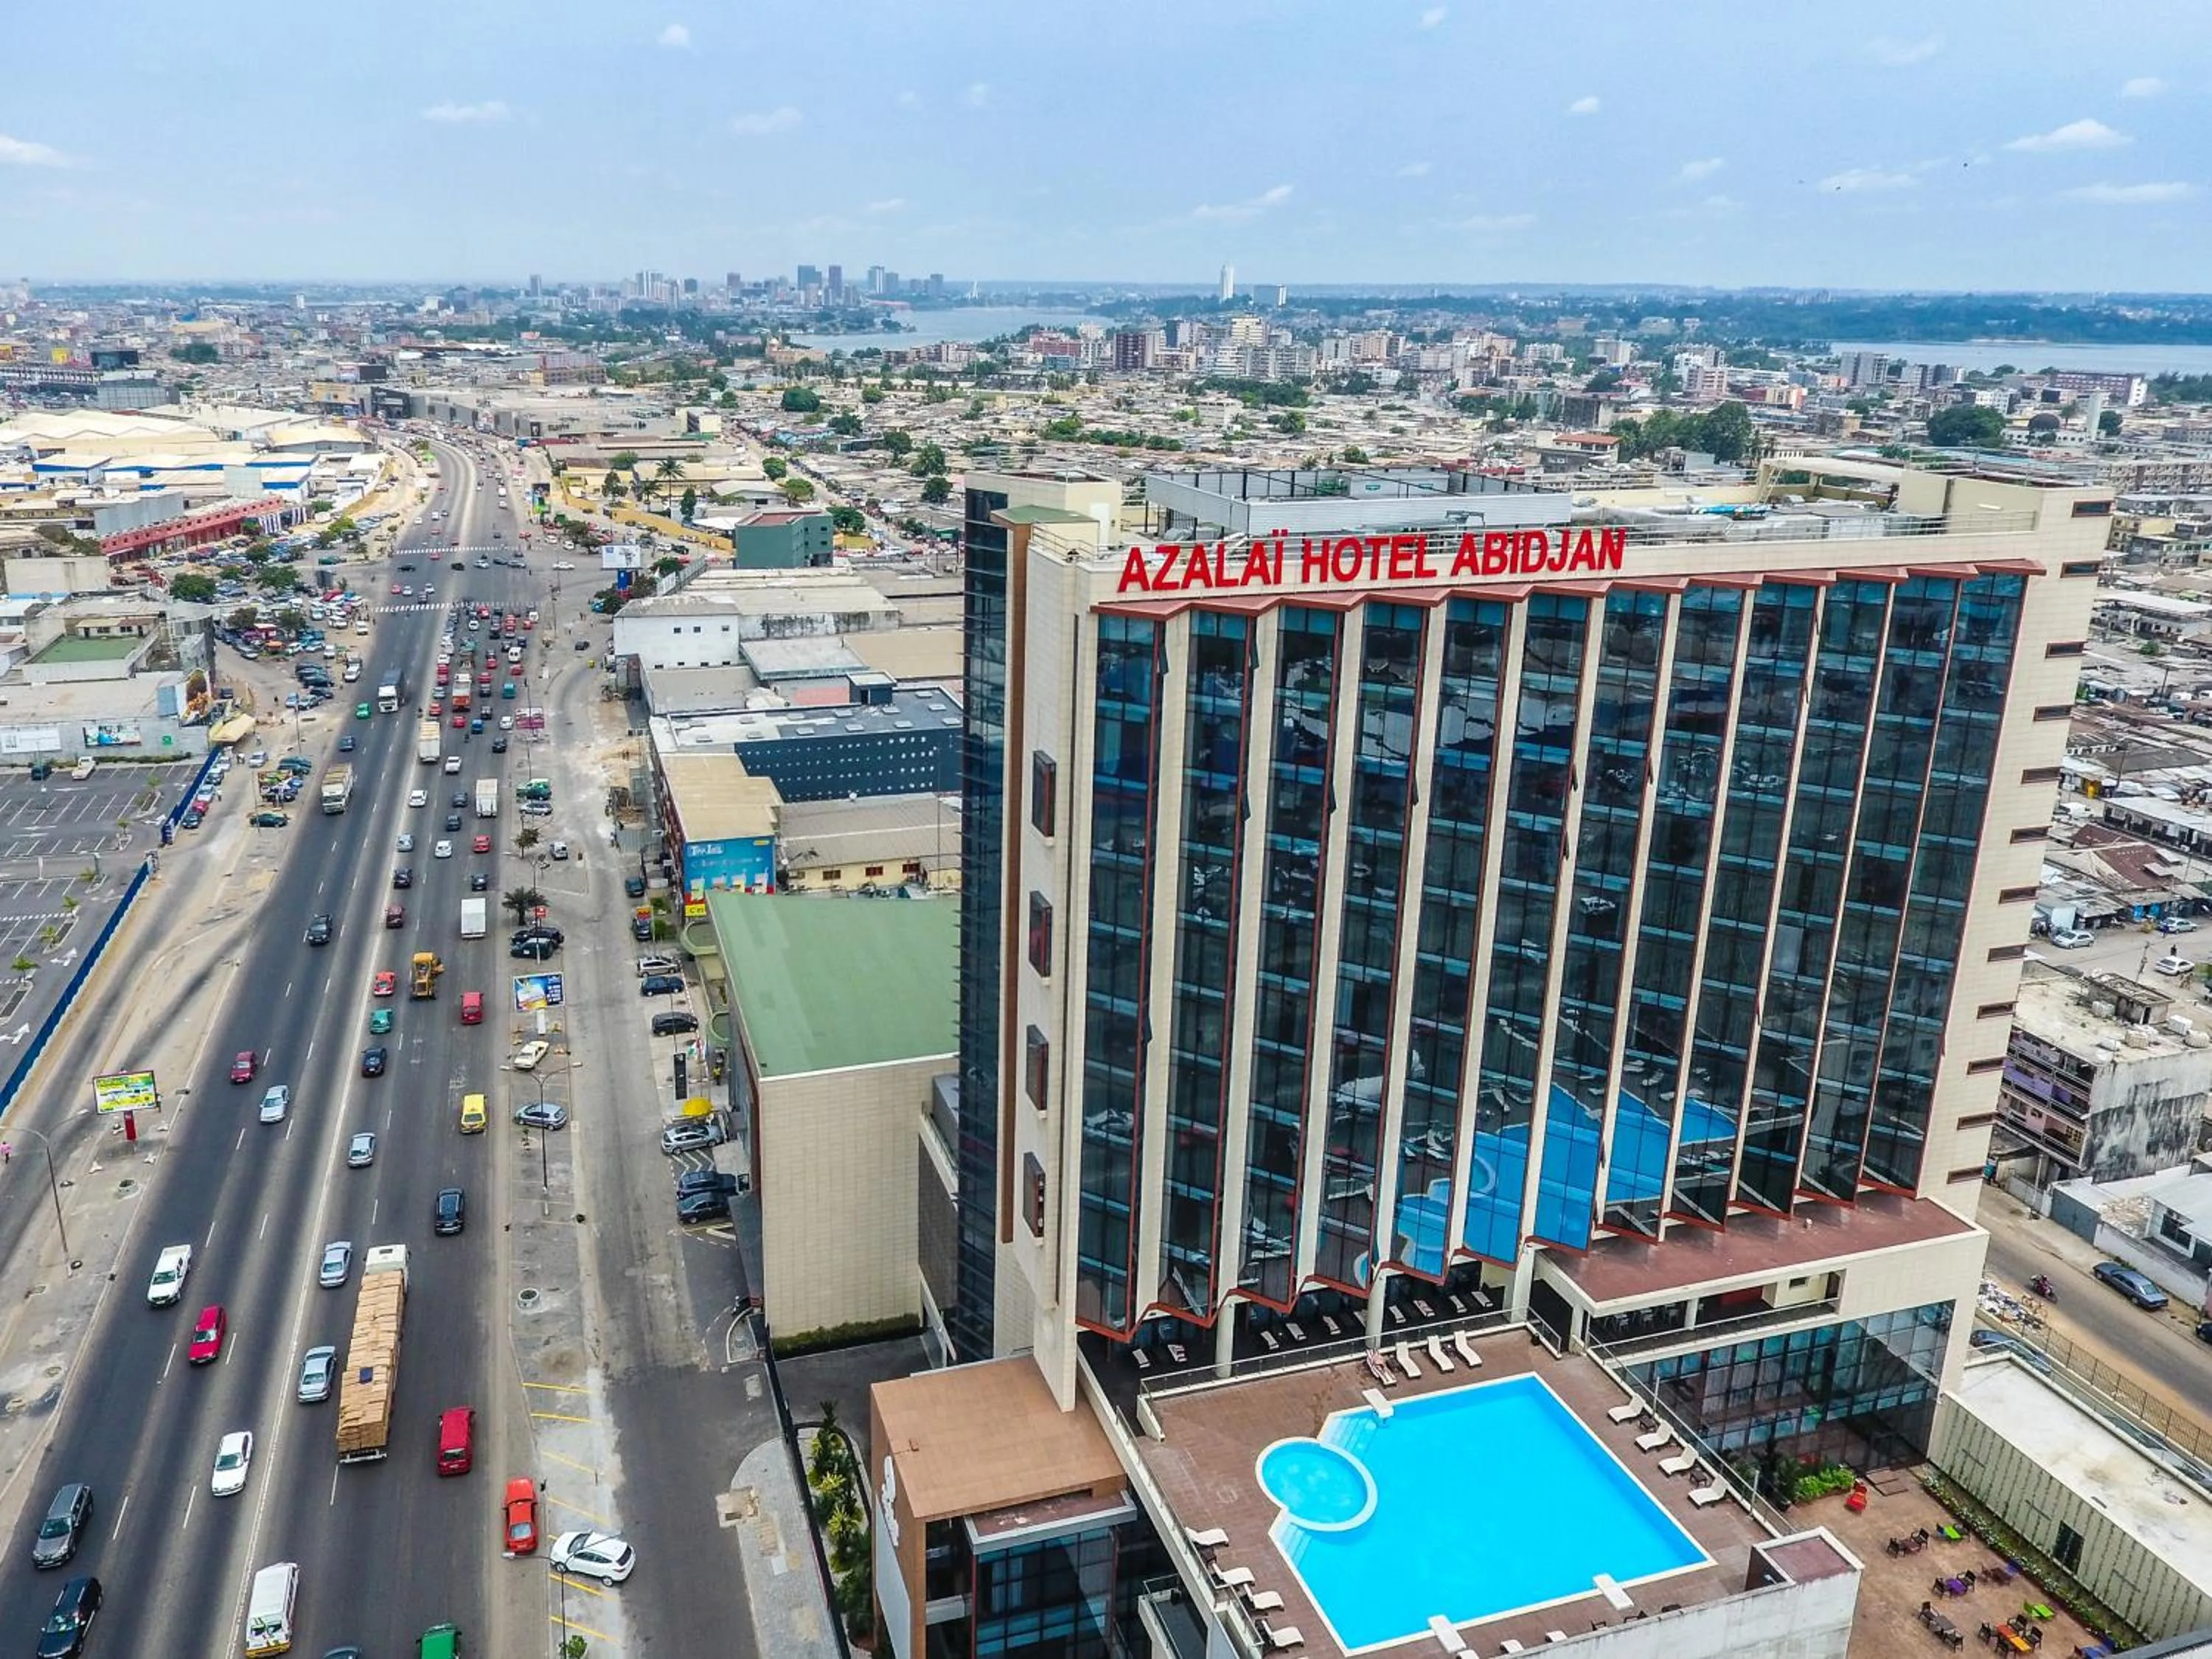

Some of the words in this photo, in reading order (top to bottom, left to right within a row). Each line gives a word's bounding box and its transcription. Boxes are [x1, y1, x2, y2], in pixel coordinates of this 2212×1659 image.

[1118, 529, 1287, 593] AZALAÏ
[1301, 534, 1438, 585] HOTEL
[1450, 528, 1626, 577] ABIDJAN
